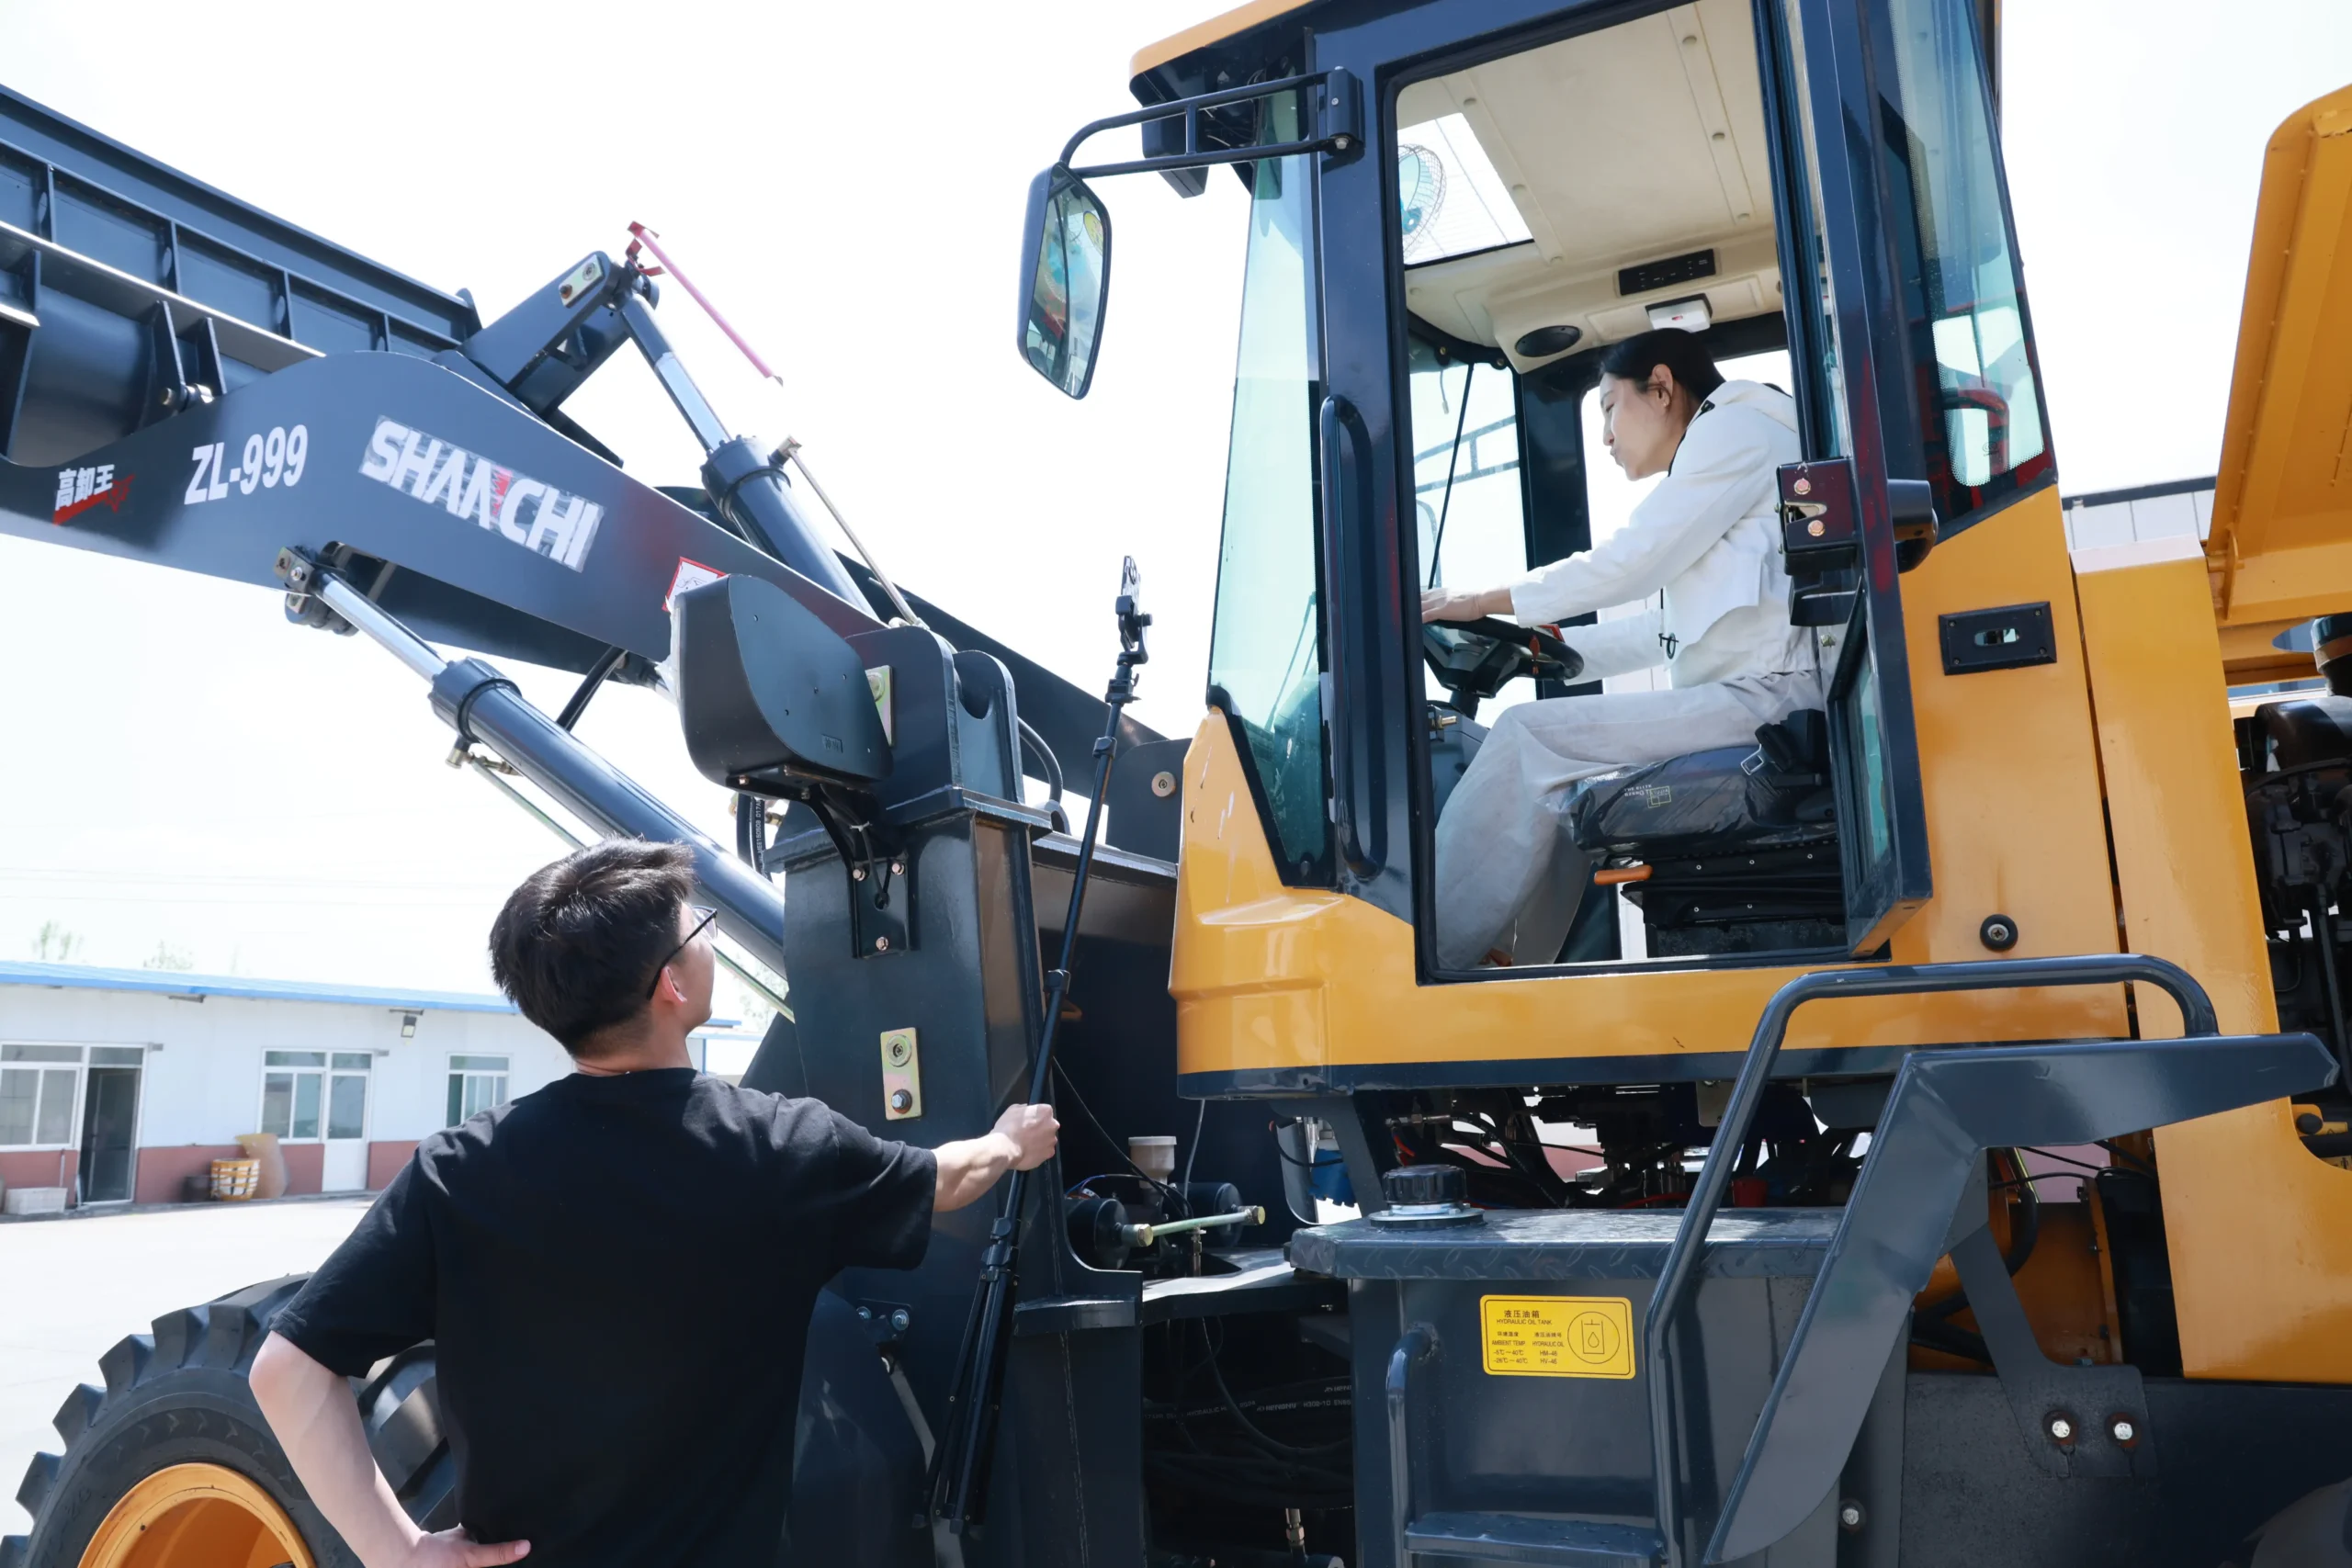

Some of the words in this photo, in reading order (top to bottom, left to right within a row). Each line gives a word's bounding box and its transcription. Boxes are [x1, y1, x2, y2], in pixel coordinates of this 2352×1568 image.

[55, 464, 115, 511] 高卸王
[183, 424, 309, 505] ZL-999
[1504, 1310, 1539, 1318] 液压油箱
